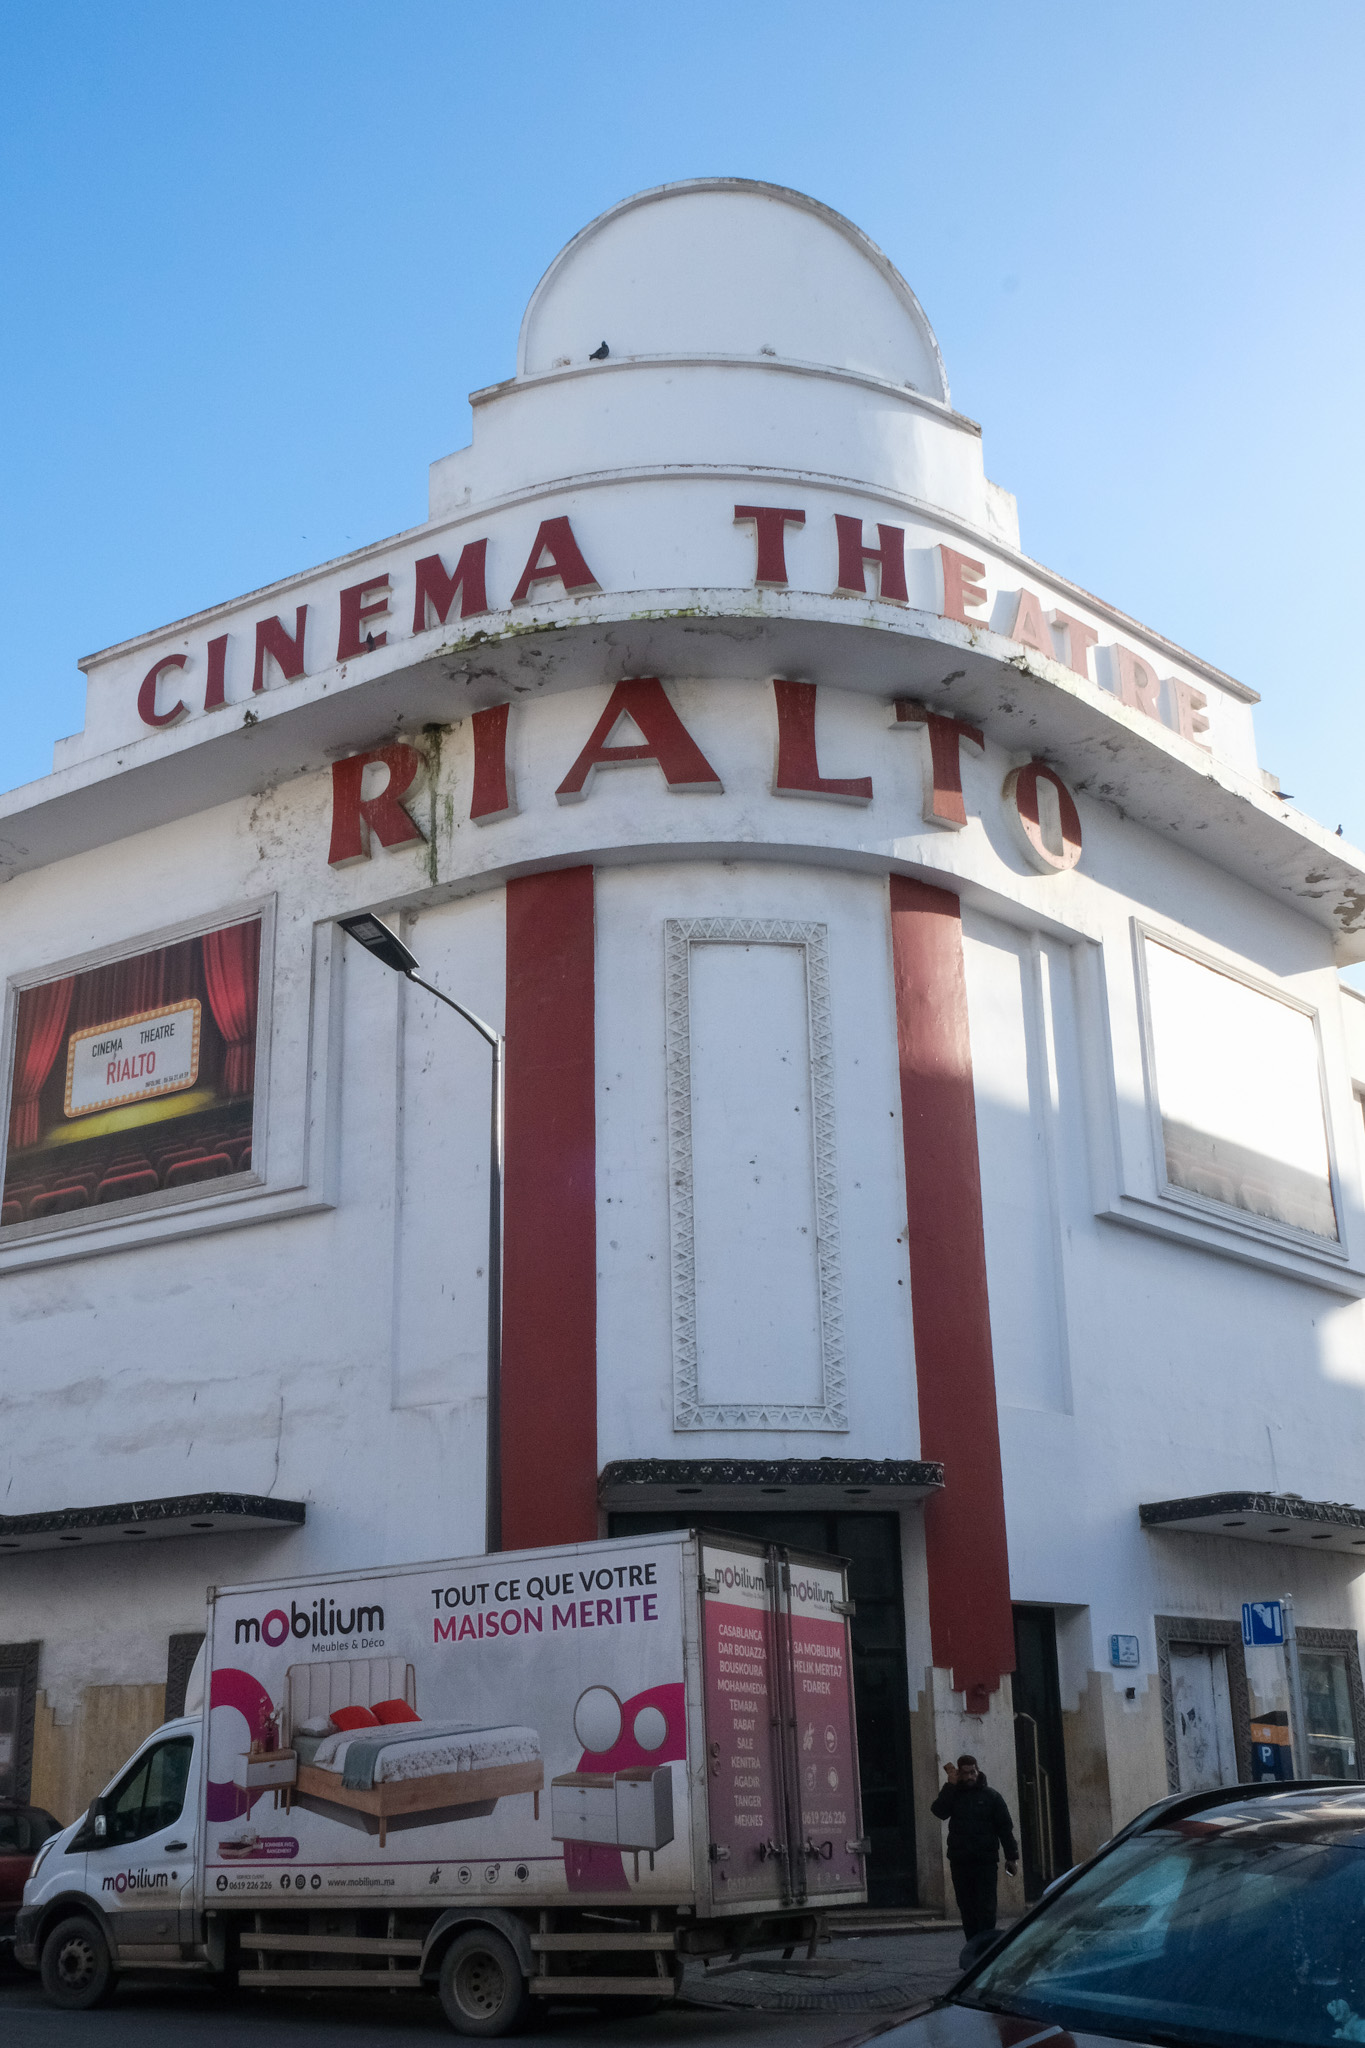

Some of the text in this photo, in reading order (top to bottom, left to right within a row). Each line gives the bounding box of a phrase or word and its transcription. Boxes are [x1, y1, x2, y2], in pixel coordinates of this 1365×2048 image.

[137, 505, 1212, 754] CINEMA THEATRE
[327, 677, 1083, 875] RIALTO
[92, 1023, 175, 1057] CINEMA THEATRE
[106, 1051, 156, 1085] RIALTO
[432, 1563, 657, 1609] TOUT CE QUE VOTRE
[715, 1565, 765, 1591] mobilium
[235, 1598, 384, 1647] mobilium
[433, 1593, 658, 1643] MAISON MERITE
[718, 1624, 763, 1642] CASABLANCA
[312, 1638, 385, 1653] Meubles & Déco
[718, 1642, 767, 1660] DAR BOUAZZA
[719, 1660, 764, 1677] BOUSKOURA
[788, 1658, 814, 1674] HELIK
[717, 1679, 768, 1696] MOHAMMEDIA
[802, 1680, 831, 1695] FDAREK
[729, 1699, 758, 1713] TEMARA
[733, 1718, 755, 1731] RABAT
[737, 1738, 753, 1750] SALE
[731, 1756, 761, 1769] KENITRA
[1261, 1746, 1272, 1763] P
[734, 1775, 760, 1788] AGADIR
[734, 1795, 762, 1807] TANGER
[734, 1814, 763, 1827] MEKNES
[820, 1811, 833, 1824] 226
[102, 1868, 168, 1893] mobilium
[229, 1881, 272, 1890] 0619 226 226
